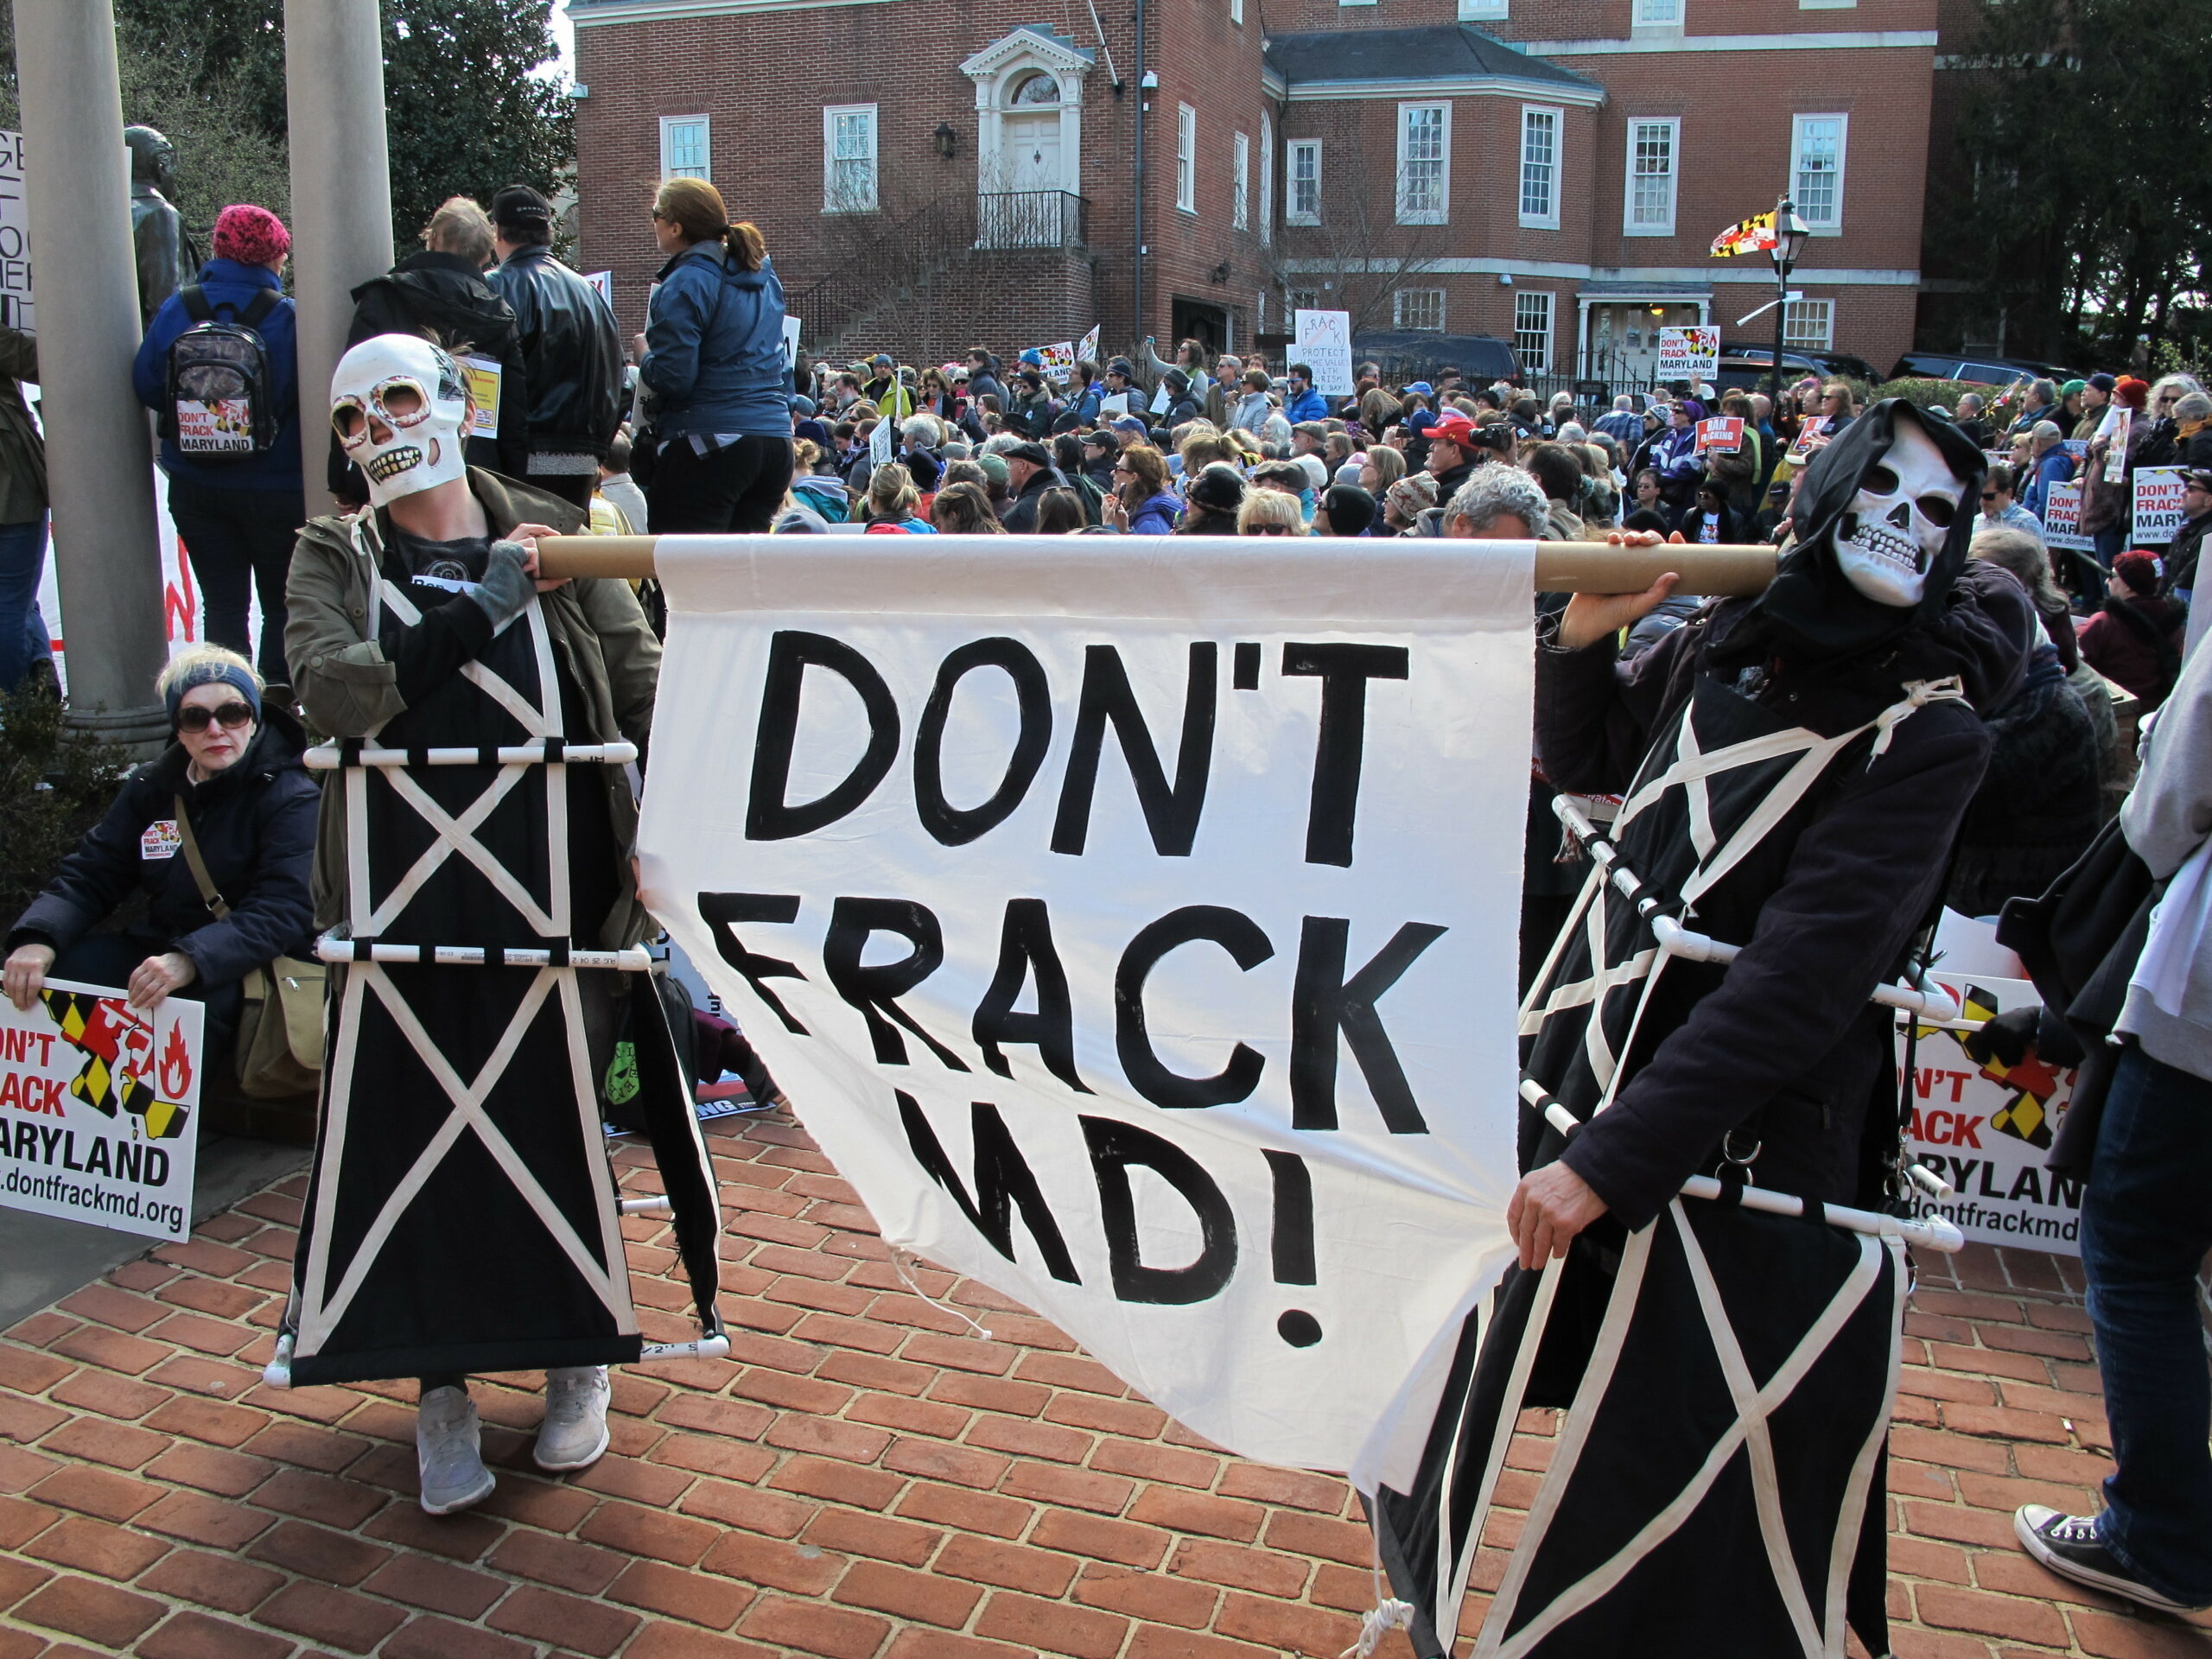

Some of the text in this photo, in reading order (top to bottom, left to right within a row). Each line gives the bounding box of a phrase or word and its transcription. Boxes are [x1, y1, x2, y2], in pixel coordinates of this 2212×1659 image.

[1305, 315, 1341, 344] FRACK
[1301, 347, 1345, 357] PROTECT
[1660, 349, 1688, 358] FRACK
[1660, 359, 1713, 369] MARYLAND
[180, 424, 214, 436] FRACK
[1707, 419, 1727, 432] BAN
[181, 439, 250, 450] MARYLAND
[2136, 484, 2181, 497] DON'T
[2136, 499, 2182, 512] FRAC
[2047, 509, 2080, 521] FRAC
[745, 629, 1409, 868] DON'T
[696, 892, 1449, 1135] FRACK
[0, 1027, 56, 1068] N'T
[1899, 1066, 1973, 1103] N'T
[893, 1087, 1325, 1349] MD!
